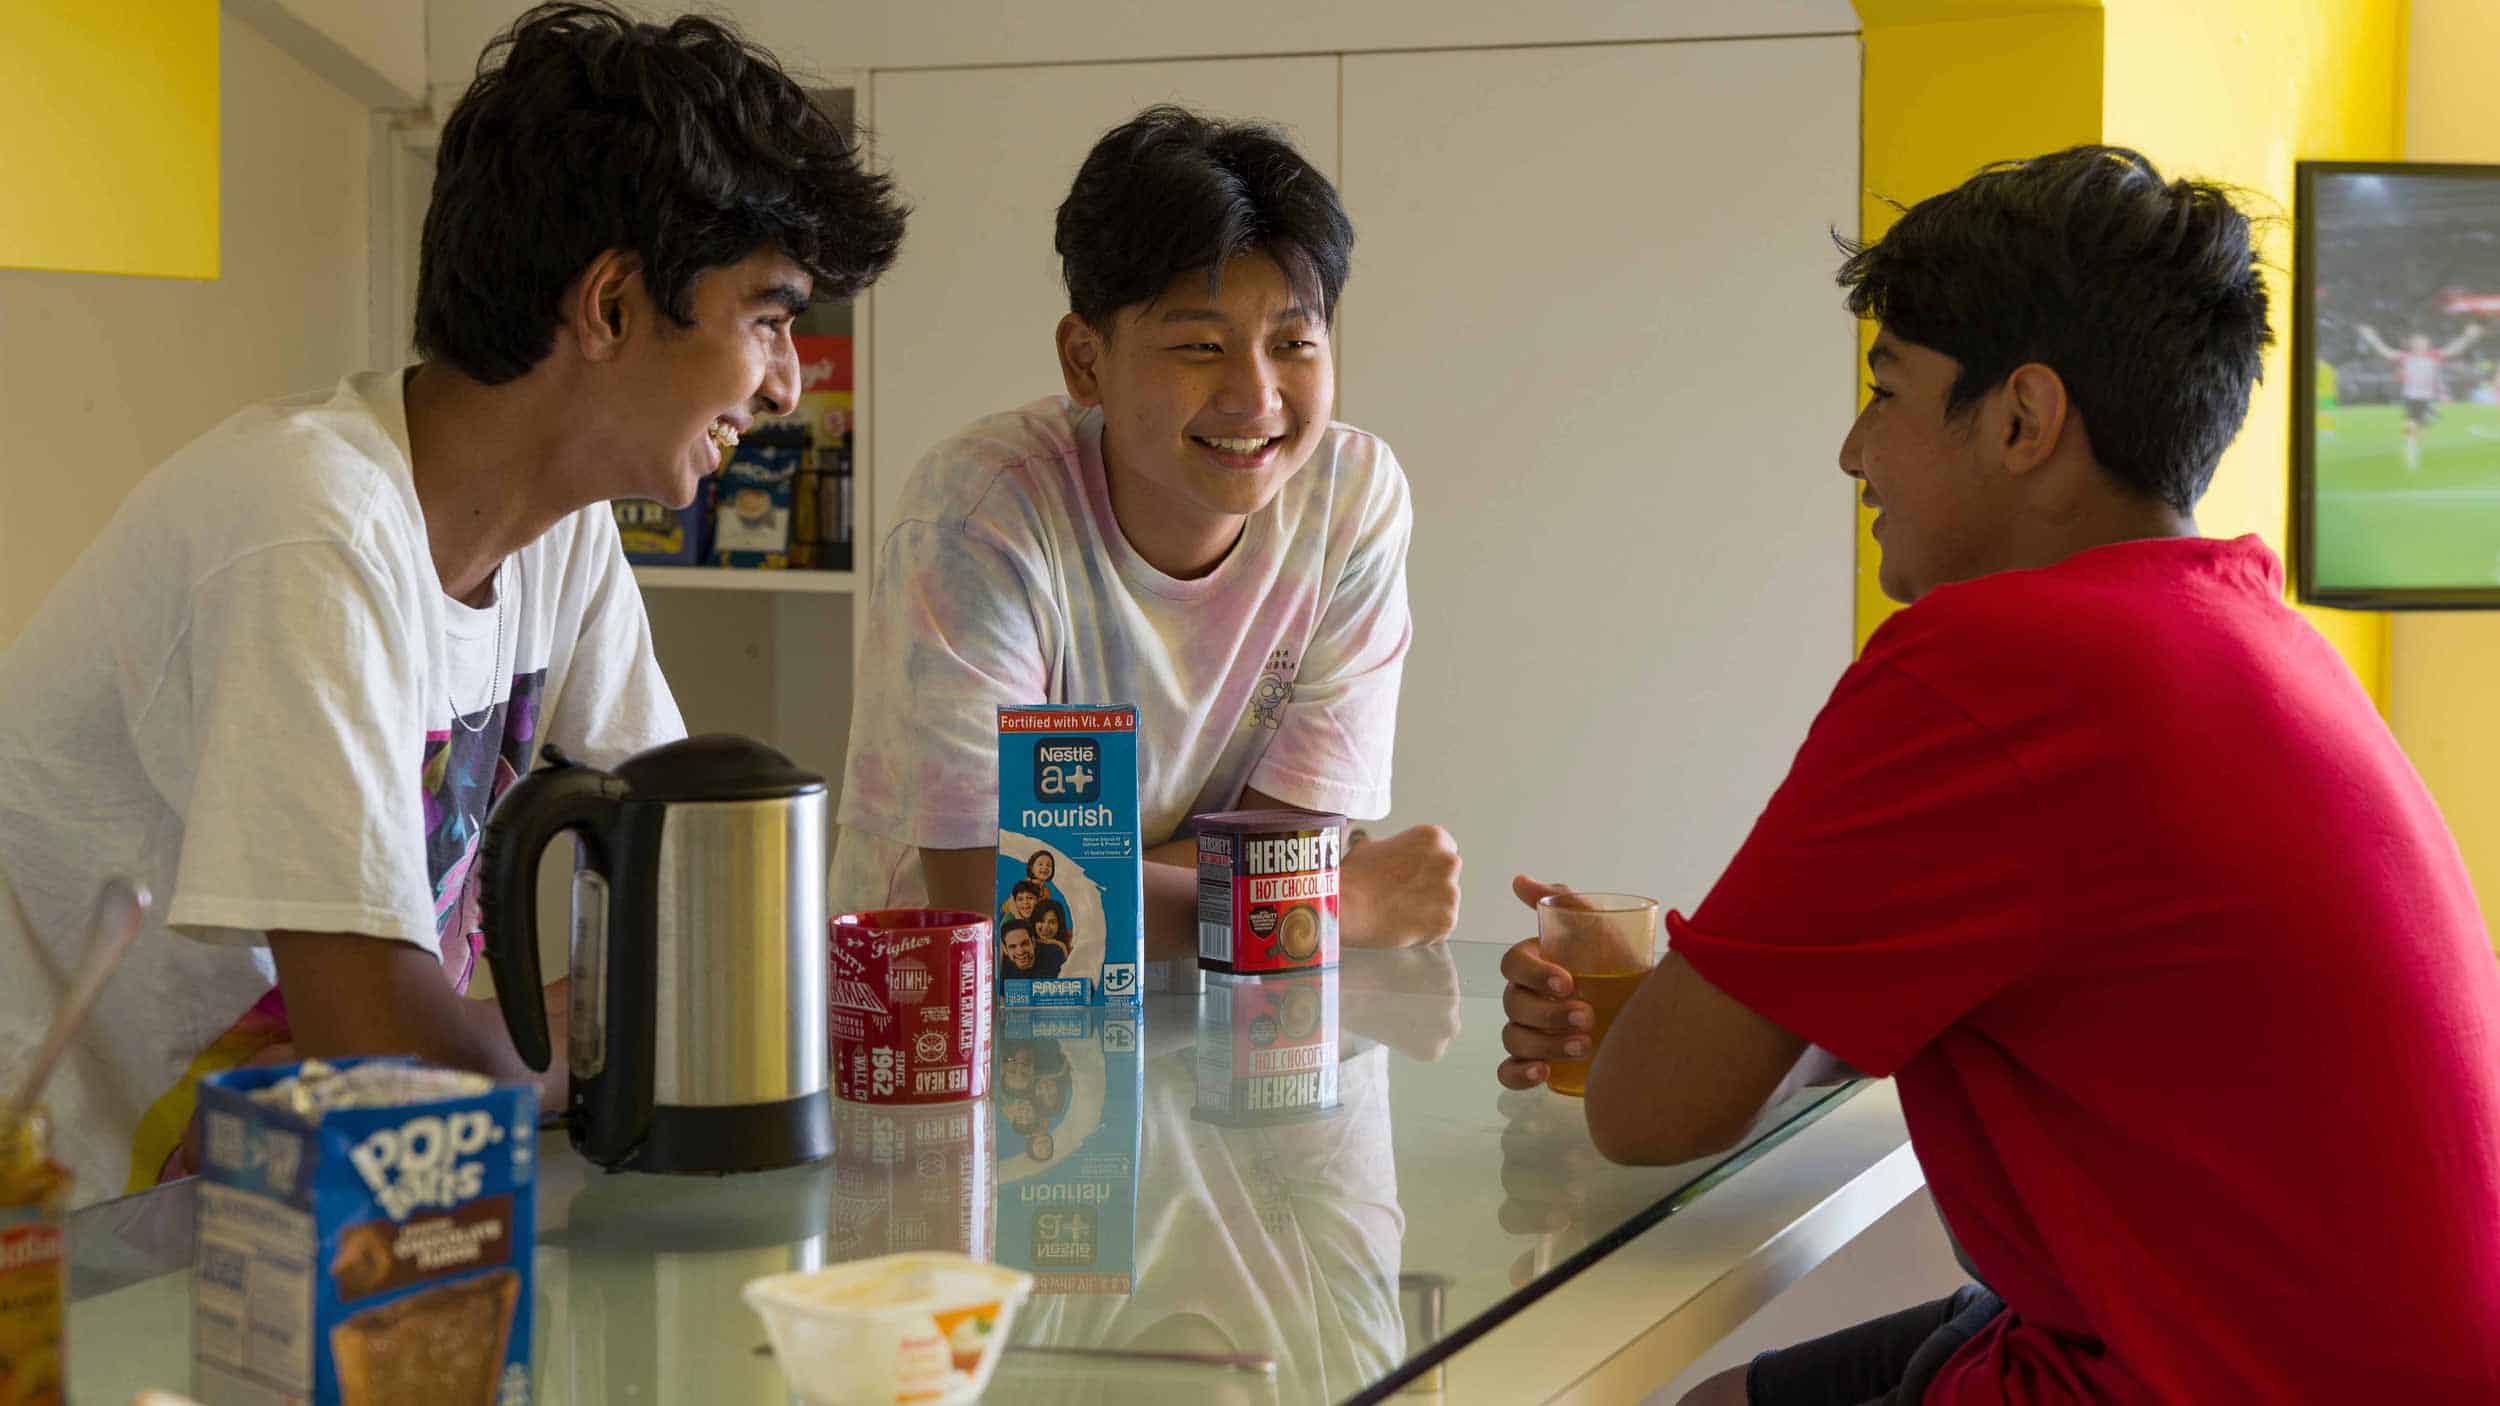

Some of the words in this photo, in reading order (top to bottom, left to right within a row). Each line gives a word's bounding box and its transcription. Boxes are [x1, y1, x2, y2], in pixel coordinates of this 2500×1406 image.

[1001, 715, 1051, 729] Fortified
[1053, 716, 1079, 728] with
[1081, 715, 1100, 728] Vit.
[1103, 716, 1112, 727] A
[1114, 716, 1122, 727] &
[1040, 765, 1094, 795] a+
[1022, 804, 1113, 828] nourish
[1250, 833, 1339, 874] HERSHEY'S
[1256, 880, 1280, 900] HOT
[870, 935, 931, 960] Fighter
[960, 963, 975, 994] WALL
[960, 996, 974, 1052] CRAWLER
[872, 1045, 894, 1096] 1962
[895, 1050, 906, 1088] SINCE
[915, 1070, 947, 1091] HEAD
